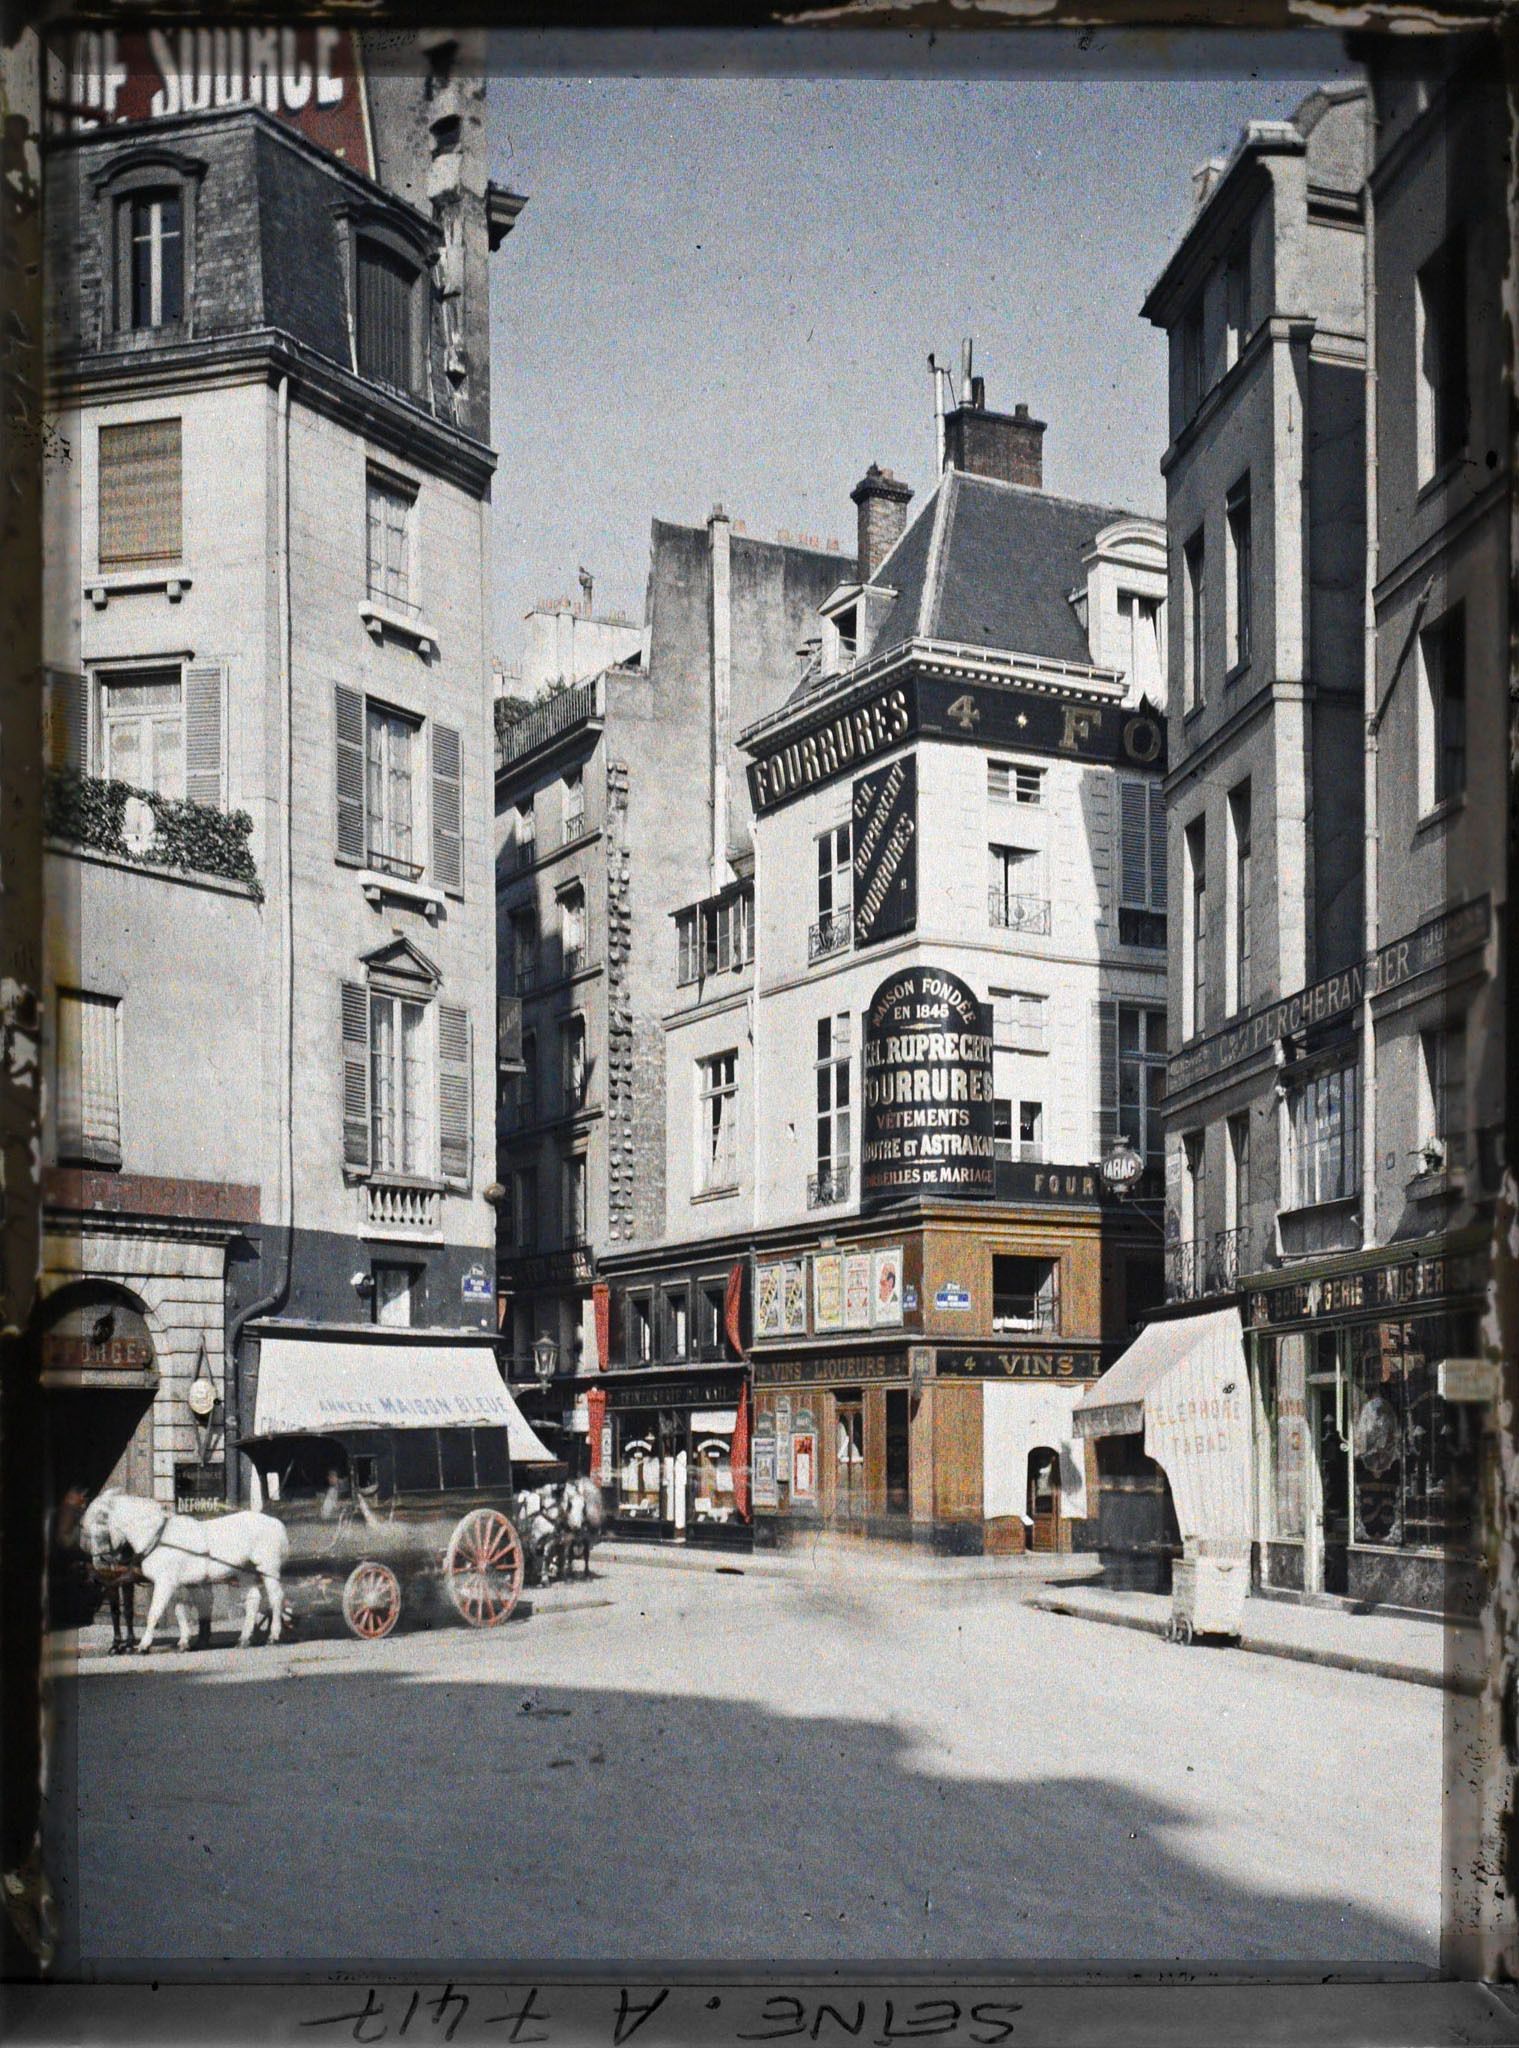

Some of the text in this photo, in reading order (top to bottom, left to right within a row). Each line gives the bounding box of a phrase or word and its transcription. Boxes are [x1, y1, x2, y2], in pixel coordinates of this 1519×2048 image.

[947, 695, 981, 732] 4
[754, 690, 909, 806] FOURRURES
[854, 761, 907, 880] RUPRECHT
[855, 812, 915, 938] FOURRURES
[873, 977, 976, 1027] MAISON FONDÉE
[1253, 942, 1409, 1050] PERCHERANIER
[894, 1005, 911, 1020] EN
[887, 1032, 993, 1064] RUPRECHT
[864, 1066, 993, 1107] OURRURES
[863, 1138, 901, 1160] OUTRE
[923, 1170, 937, 1183] DE
[939, 1167, 993, 1184] MARIAGE
[1103, 1157, 1136, 1180] TABAC
[771, 1361, 802, 1382] VINS
[814, 1355, 886, 1379] LIQUEURS
[964, 1356, 976, 1371] 4
[998, 1355, 1074, 1375] VINS
[379, 1397, 451, 1416] MAISON
[455, 1396, 509, 1414] BLEUE
[1171, 1430, 1229, 1457] TABAC
[613, 1987, 672, 2043] A
